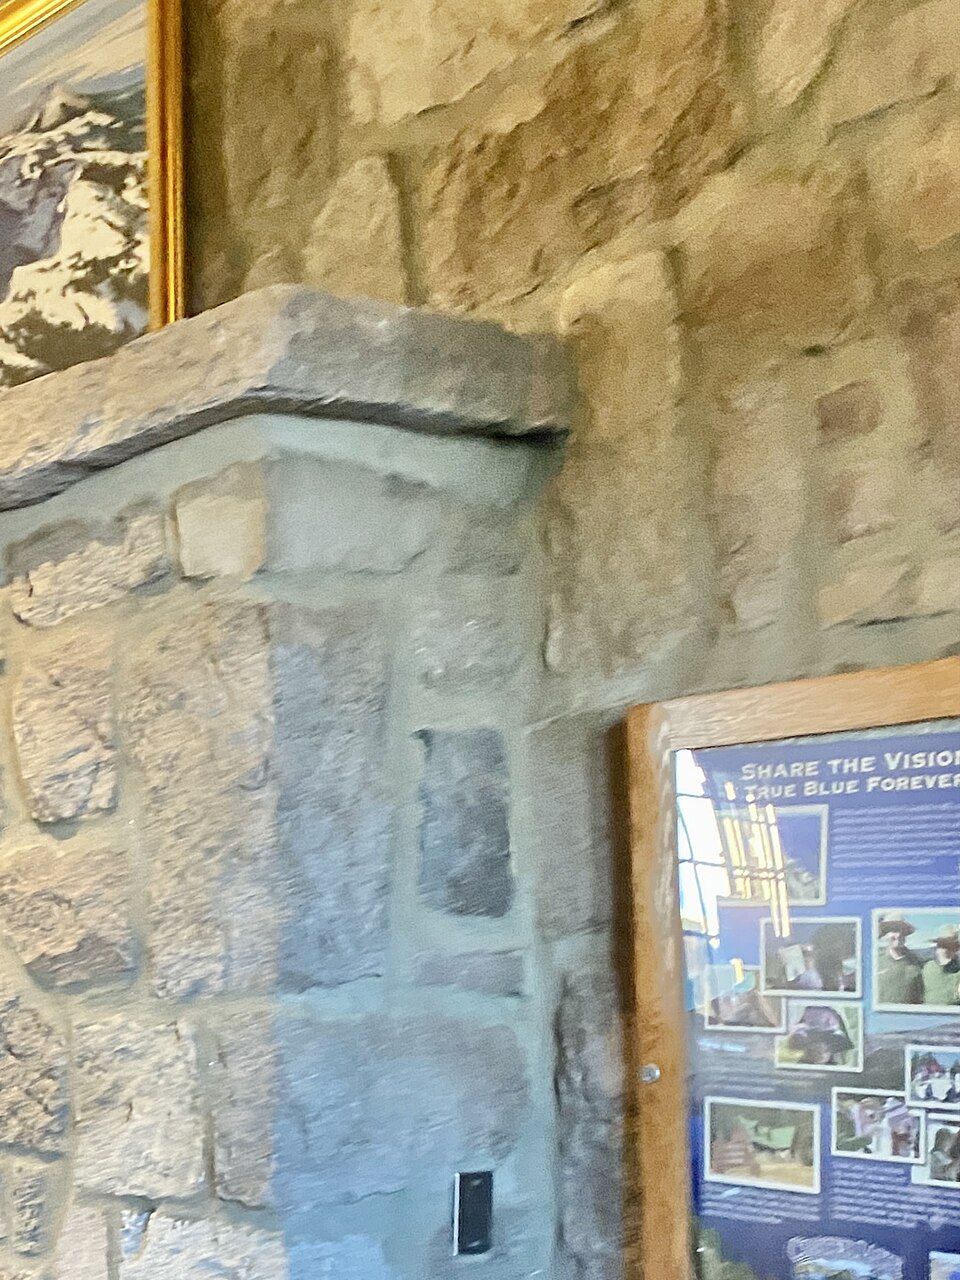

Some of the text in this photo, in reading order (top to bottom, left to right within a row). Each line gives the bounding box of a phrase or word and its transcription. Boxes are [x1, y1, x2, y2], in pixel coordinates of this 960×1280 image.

[741, 761, 820, 781] SHARE
[827, 756, 876, 774] THE
[803, 779, 860, 797] BLUE
